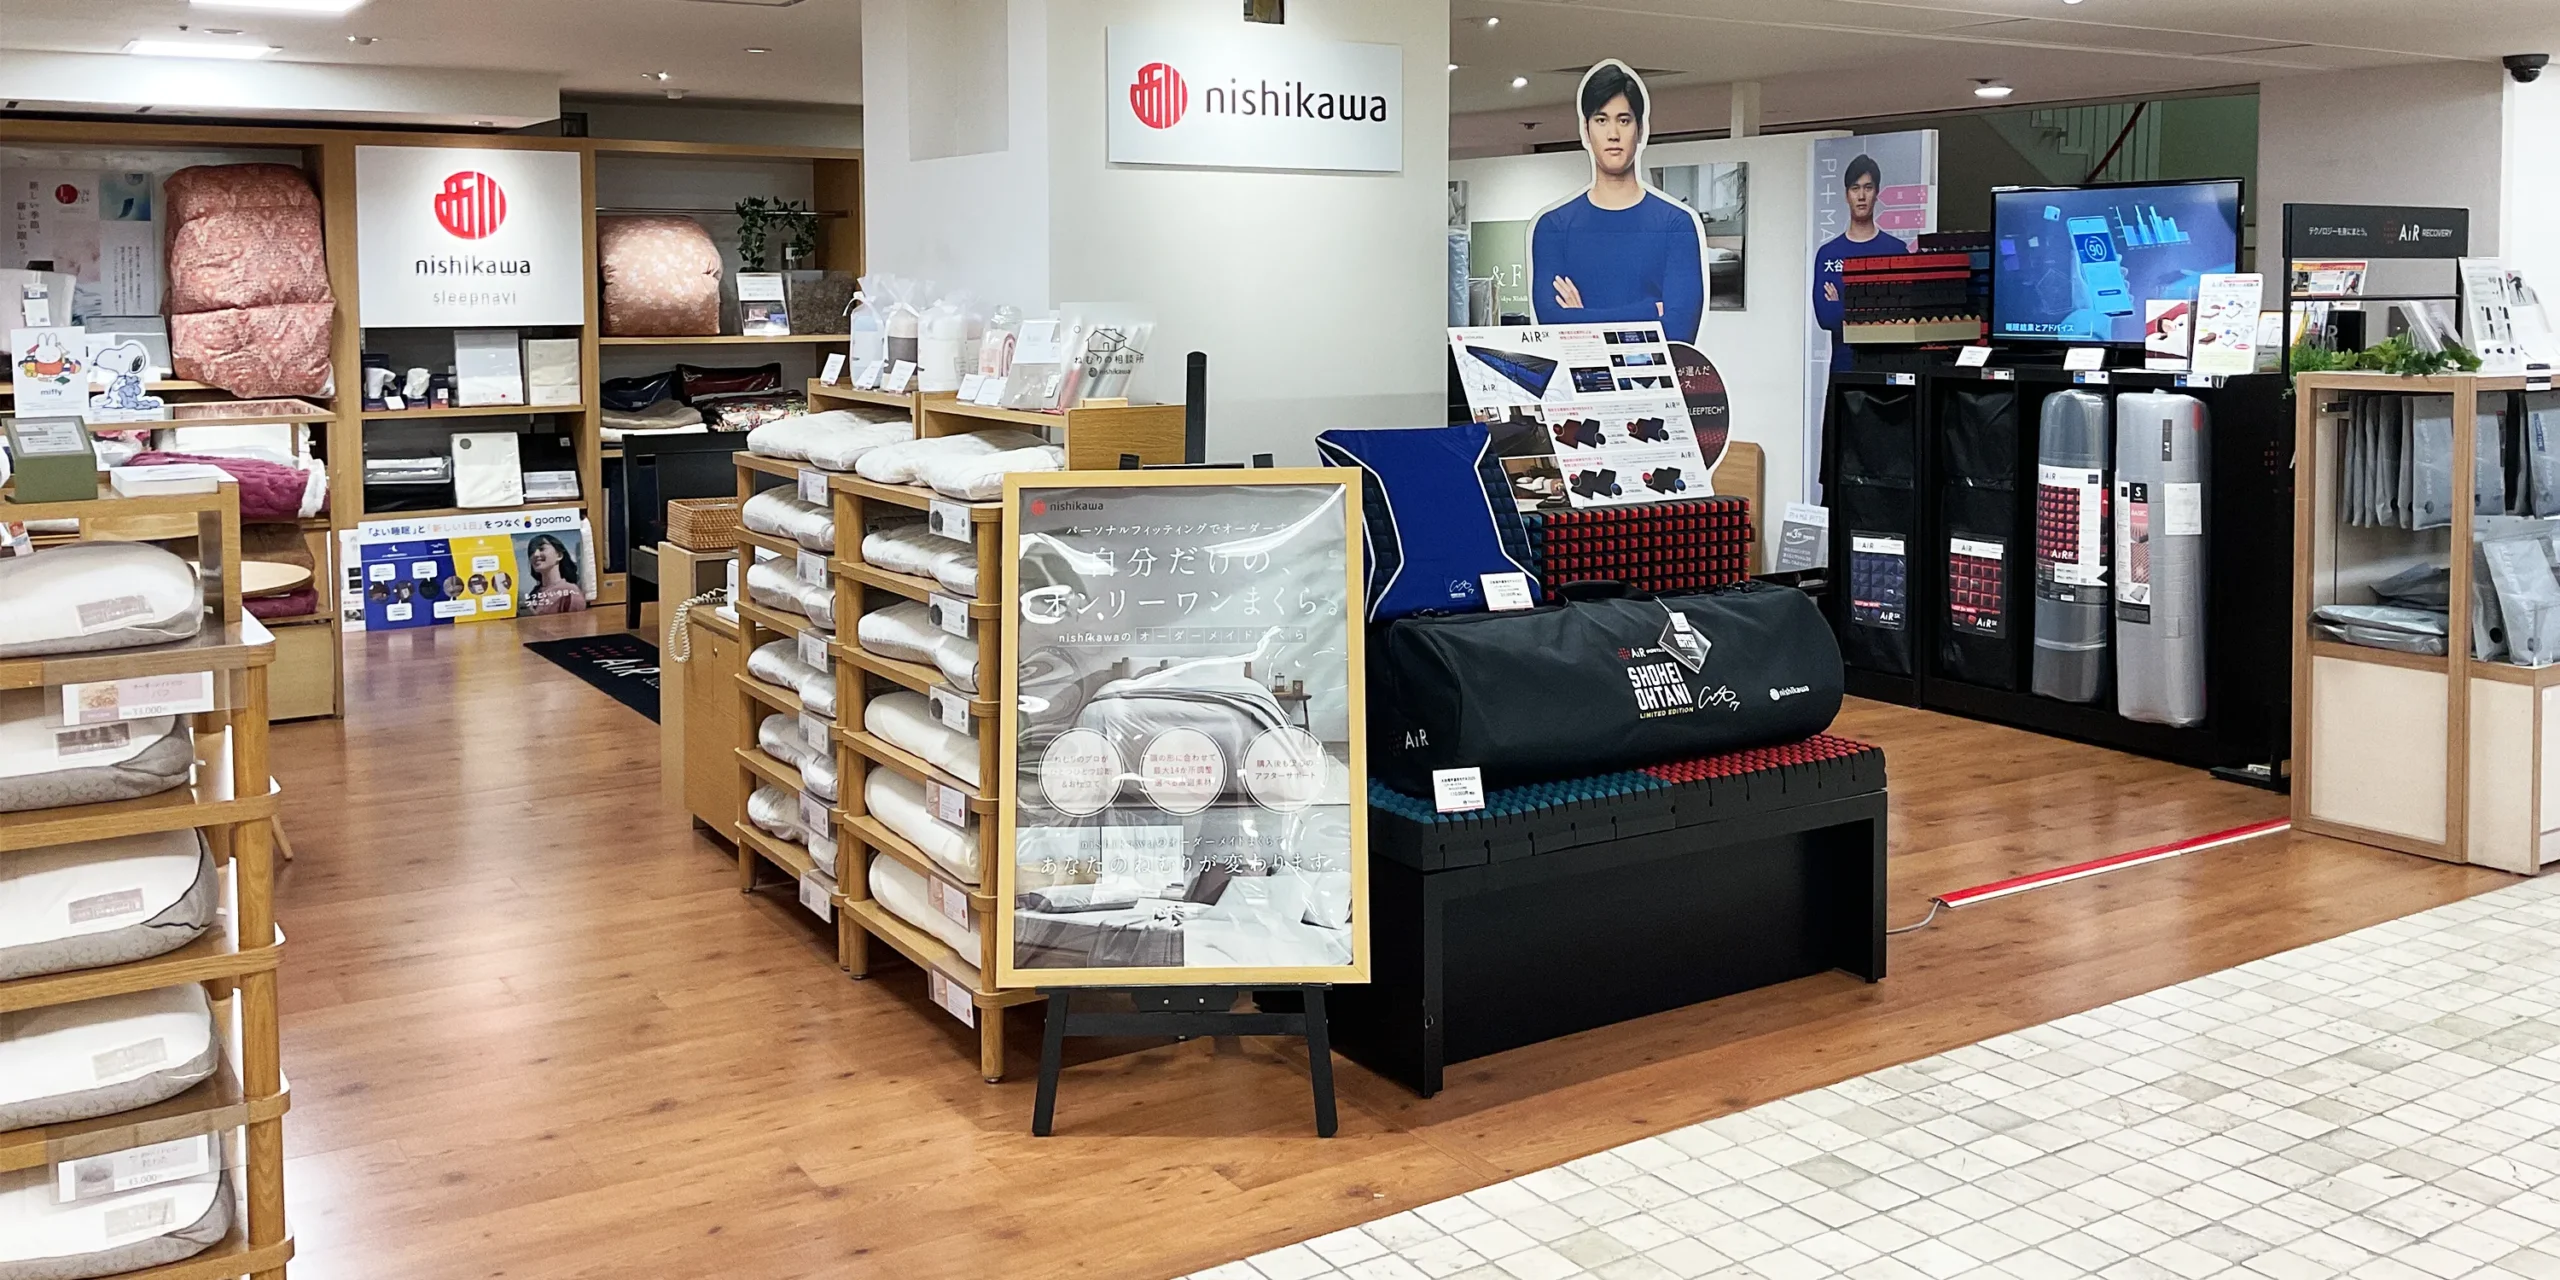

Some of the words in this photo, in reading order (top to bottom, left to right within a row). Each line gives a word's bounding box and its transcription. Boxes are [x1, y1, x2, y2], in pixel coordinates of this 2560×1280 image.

[1206, 78, 1387, 122] nishikawa
[2398, 224, 2420, 241] AiR
[2421, 229, 2453, 237] RECOVERY
[2089, 244, 2104, 257] 90
[415, 255, 531, 275] nishikawa
[433, 290, 516, 306] sleepnavi
[40, 388, 63, 397] miffy
[1050, 501, 1104, 511] nishikawa
[535, 515, 572, 527] goomo
[1092, 546, 1291, 578] 自分だけの、
[1044, 586, 1338, 618] オンリーワンまくら。
[1627, 662, 1684, 689] SHOHEI
[1634, 683, 1693, 711] OHTANI
[1779, 685, 1810, 696] nishikawa
[1640, 710, 1666, 719] LIMITED
[1668, 706, 1694, 715] EDITION
[1405, 728, 1429, 750] AiR
